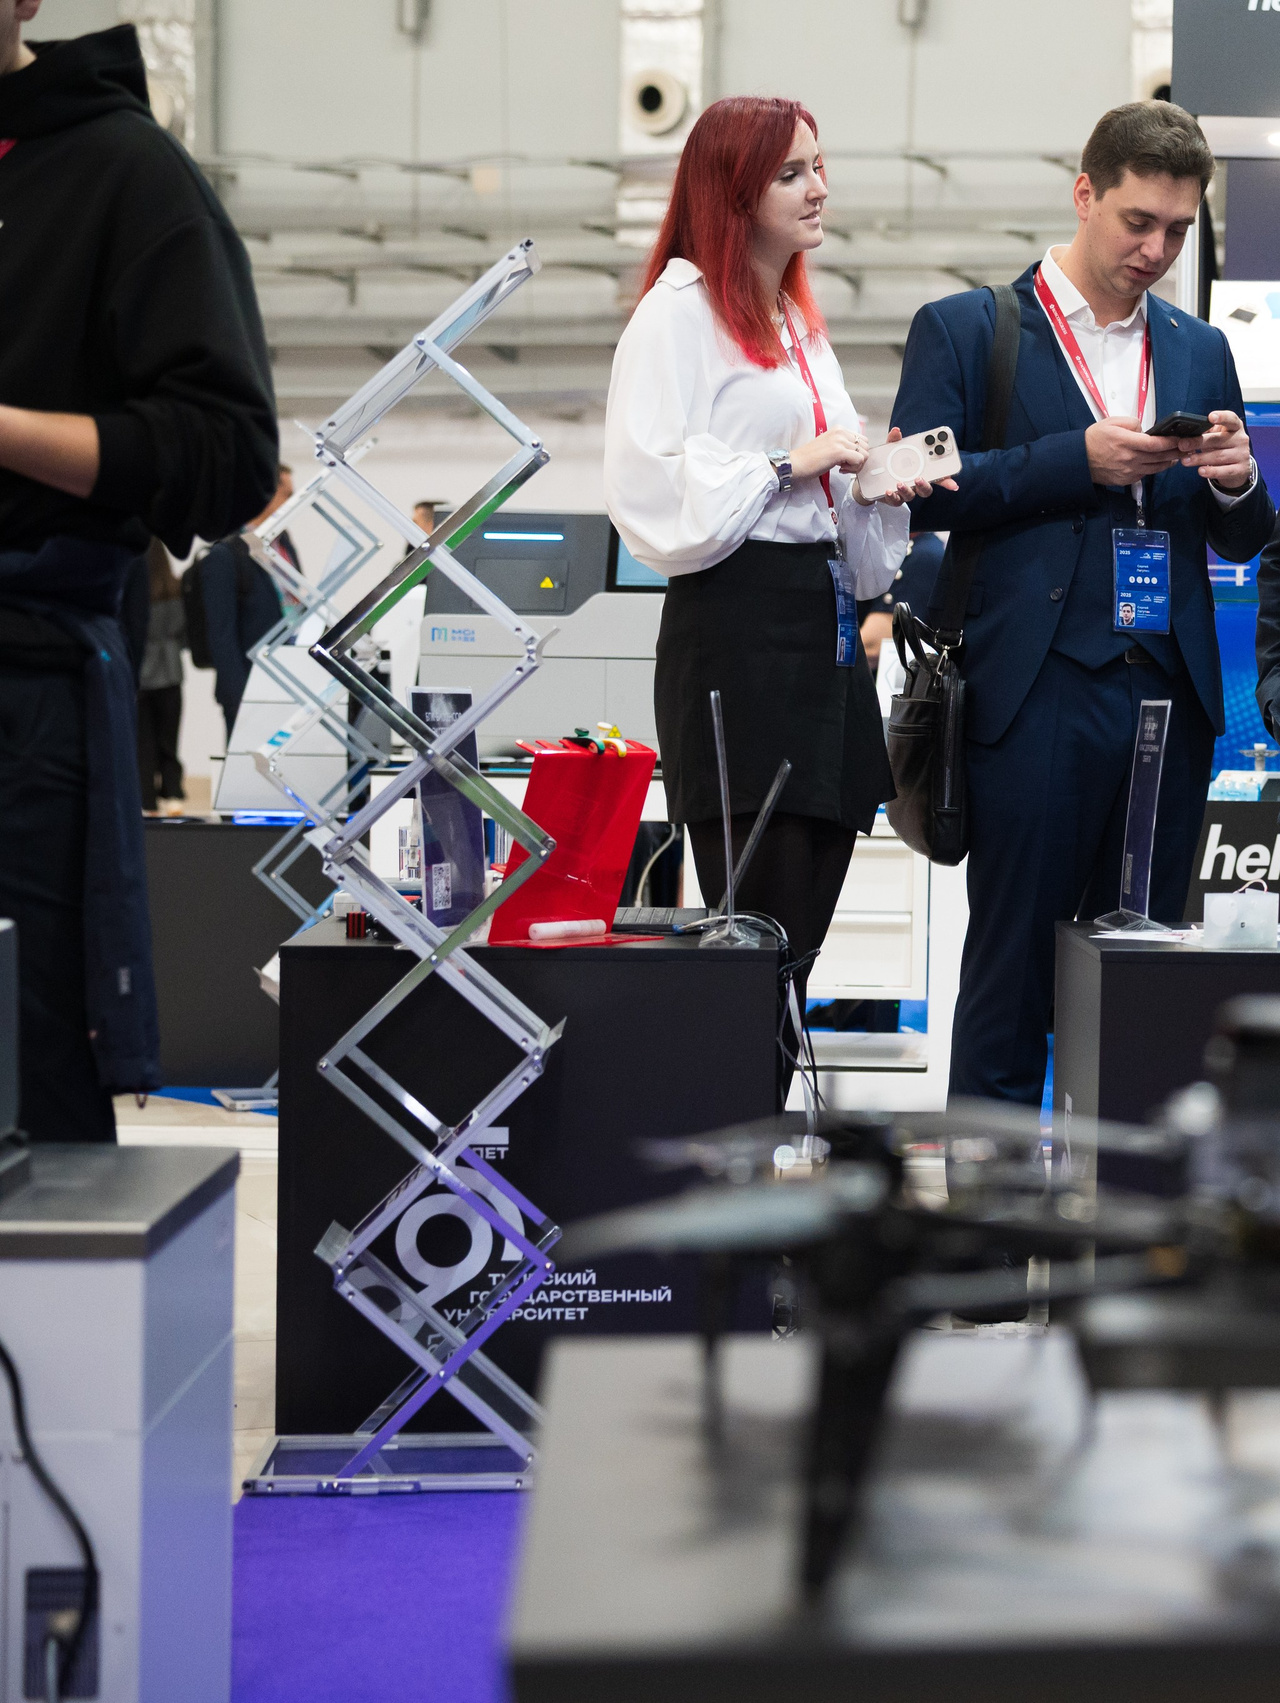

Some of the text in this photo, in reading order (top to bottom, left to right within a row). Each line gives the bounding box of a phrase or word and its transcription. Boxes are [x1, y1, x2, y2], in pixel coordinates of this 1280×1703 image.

[488, 1269, 597, 1286] ТСКИЙ
[469, 1287, 672, 1306] ГОДАРСТВЕННЫЙ
[443, 1307, 589, 1321] УНРСИТЕТ
